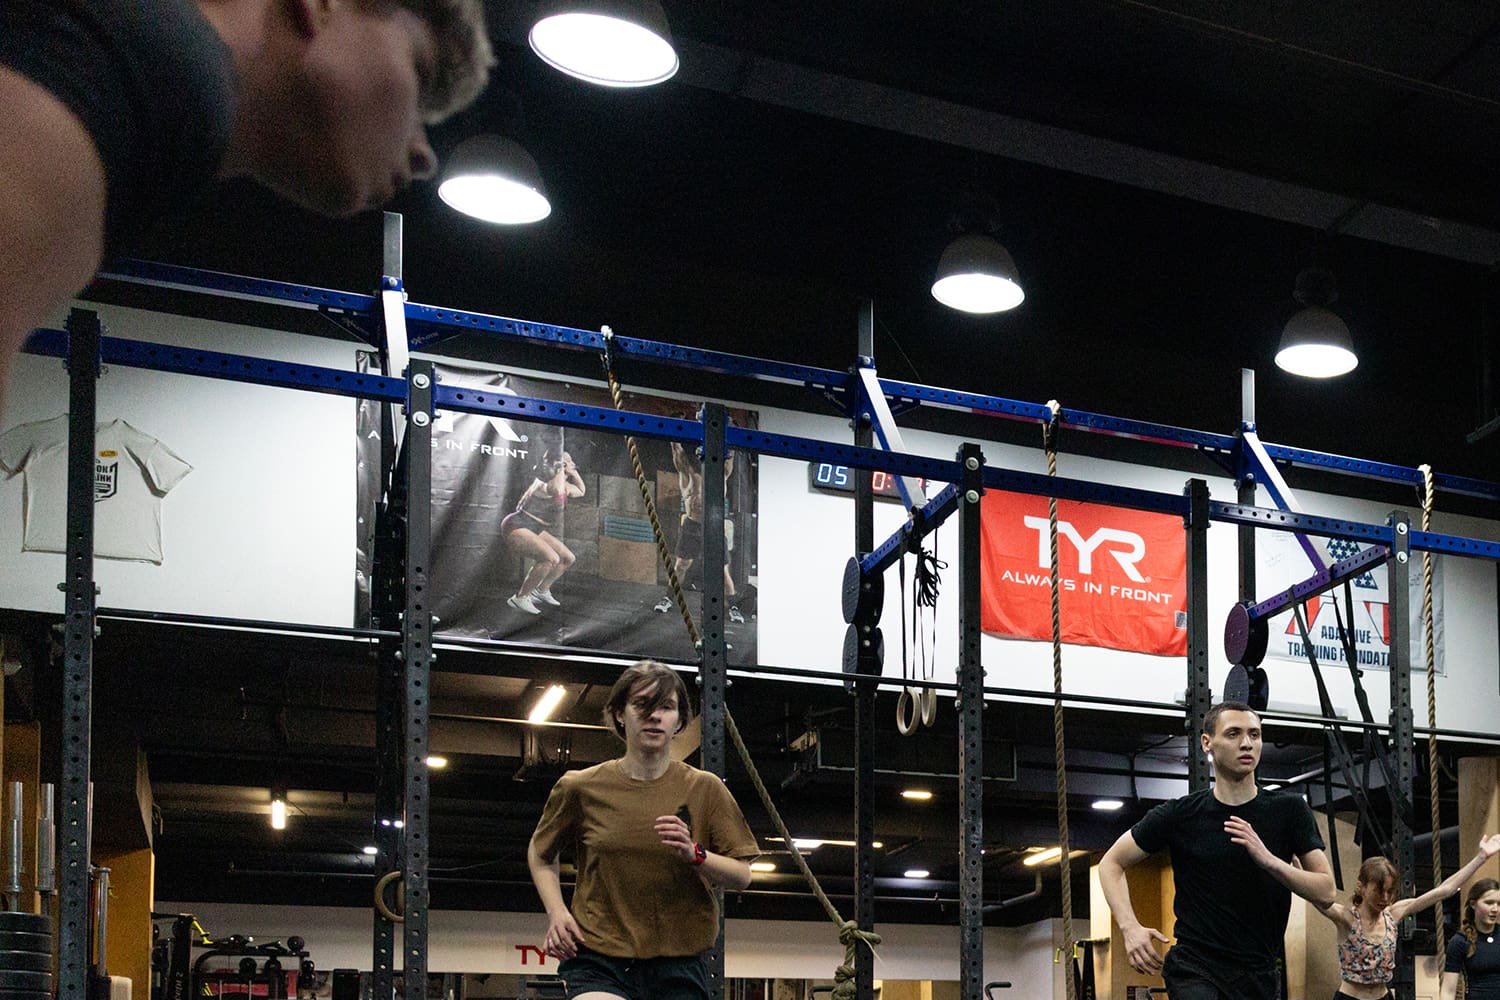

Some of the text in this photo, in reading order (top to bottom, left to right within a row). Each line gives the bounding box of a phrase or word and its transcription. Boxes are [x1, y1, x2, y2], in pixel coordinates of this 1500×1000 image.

[446, 440, 463, 449] IN
[471, 443, 529, 460] FRONT
[816, 463, 849, 485] 05
[1023, 515, 1146, 583] TYR
[1084, 581, 1103, 595] IN
[1110, 585, 1173, 605] FRONT
[1321, 625, 1371, 644] ADAIVE
[1287, 641, 1337, 661] TRANING
